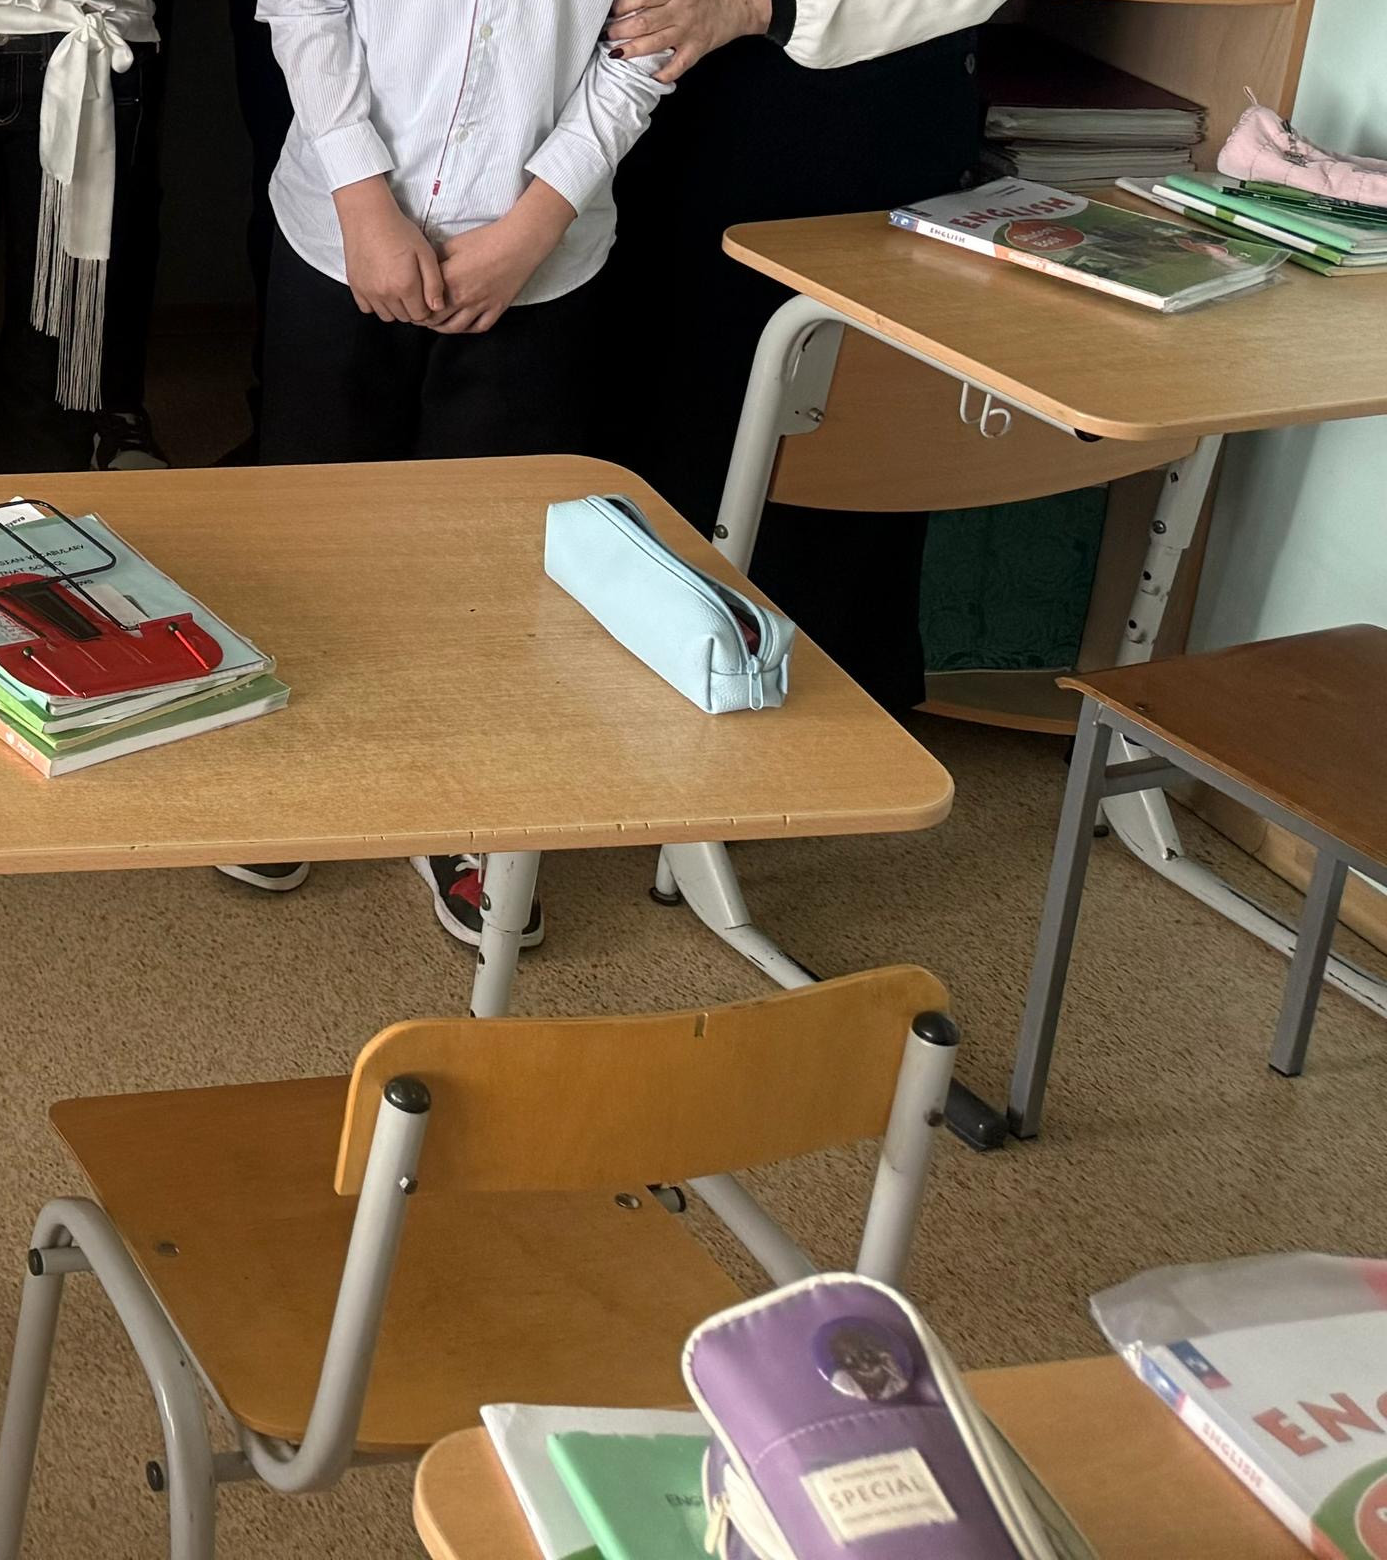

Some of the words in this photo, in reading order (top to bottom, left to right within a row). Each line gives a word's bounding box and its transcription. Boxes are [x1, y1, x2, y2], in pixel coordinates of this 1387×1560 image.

[948, 197, 1076, 230] ENGLISH
[929, 226, 966, 244] ENGLISH
[830, 1475, 925, 1511] SPECIAL
